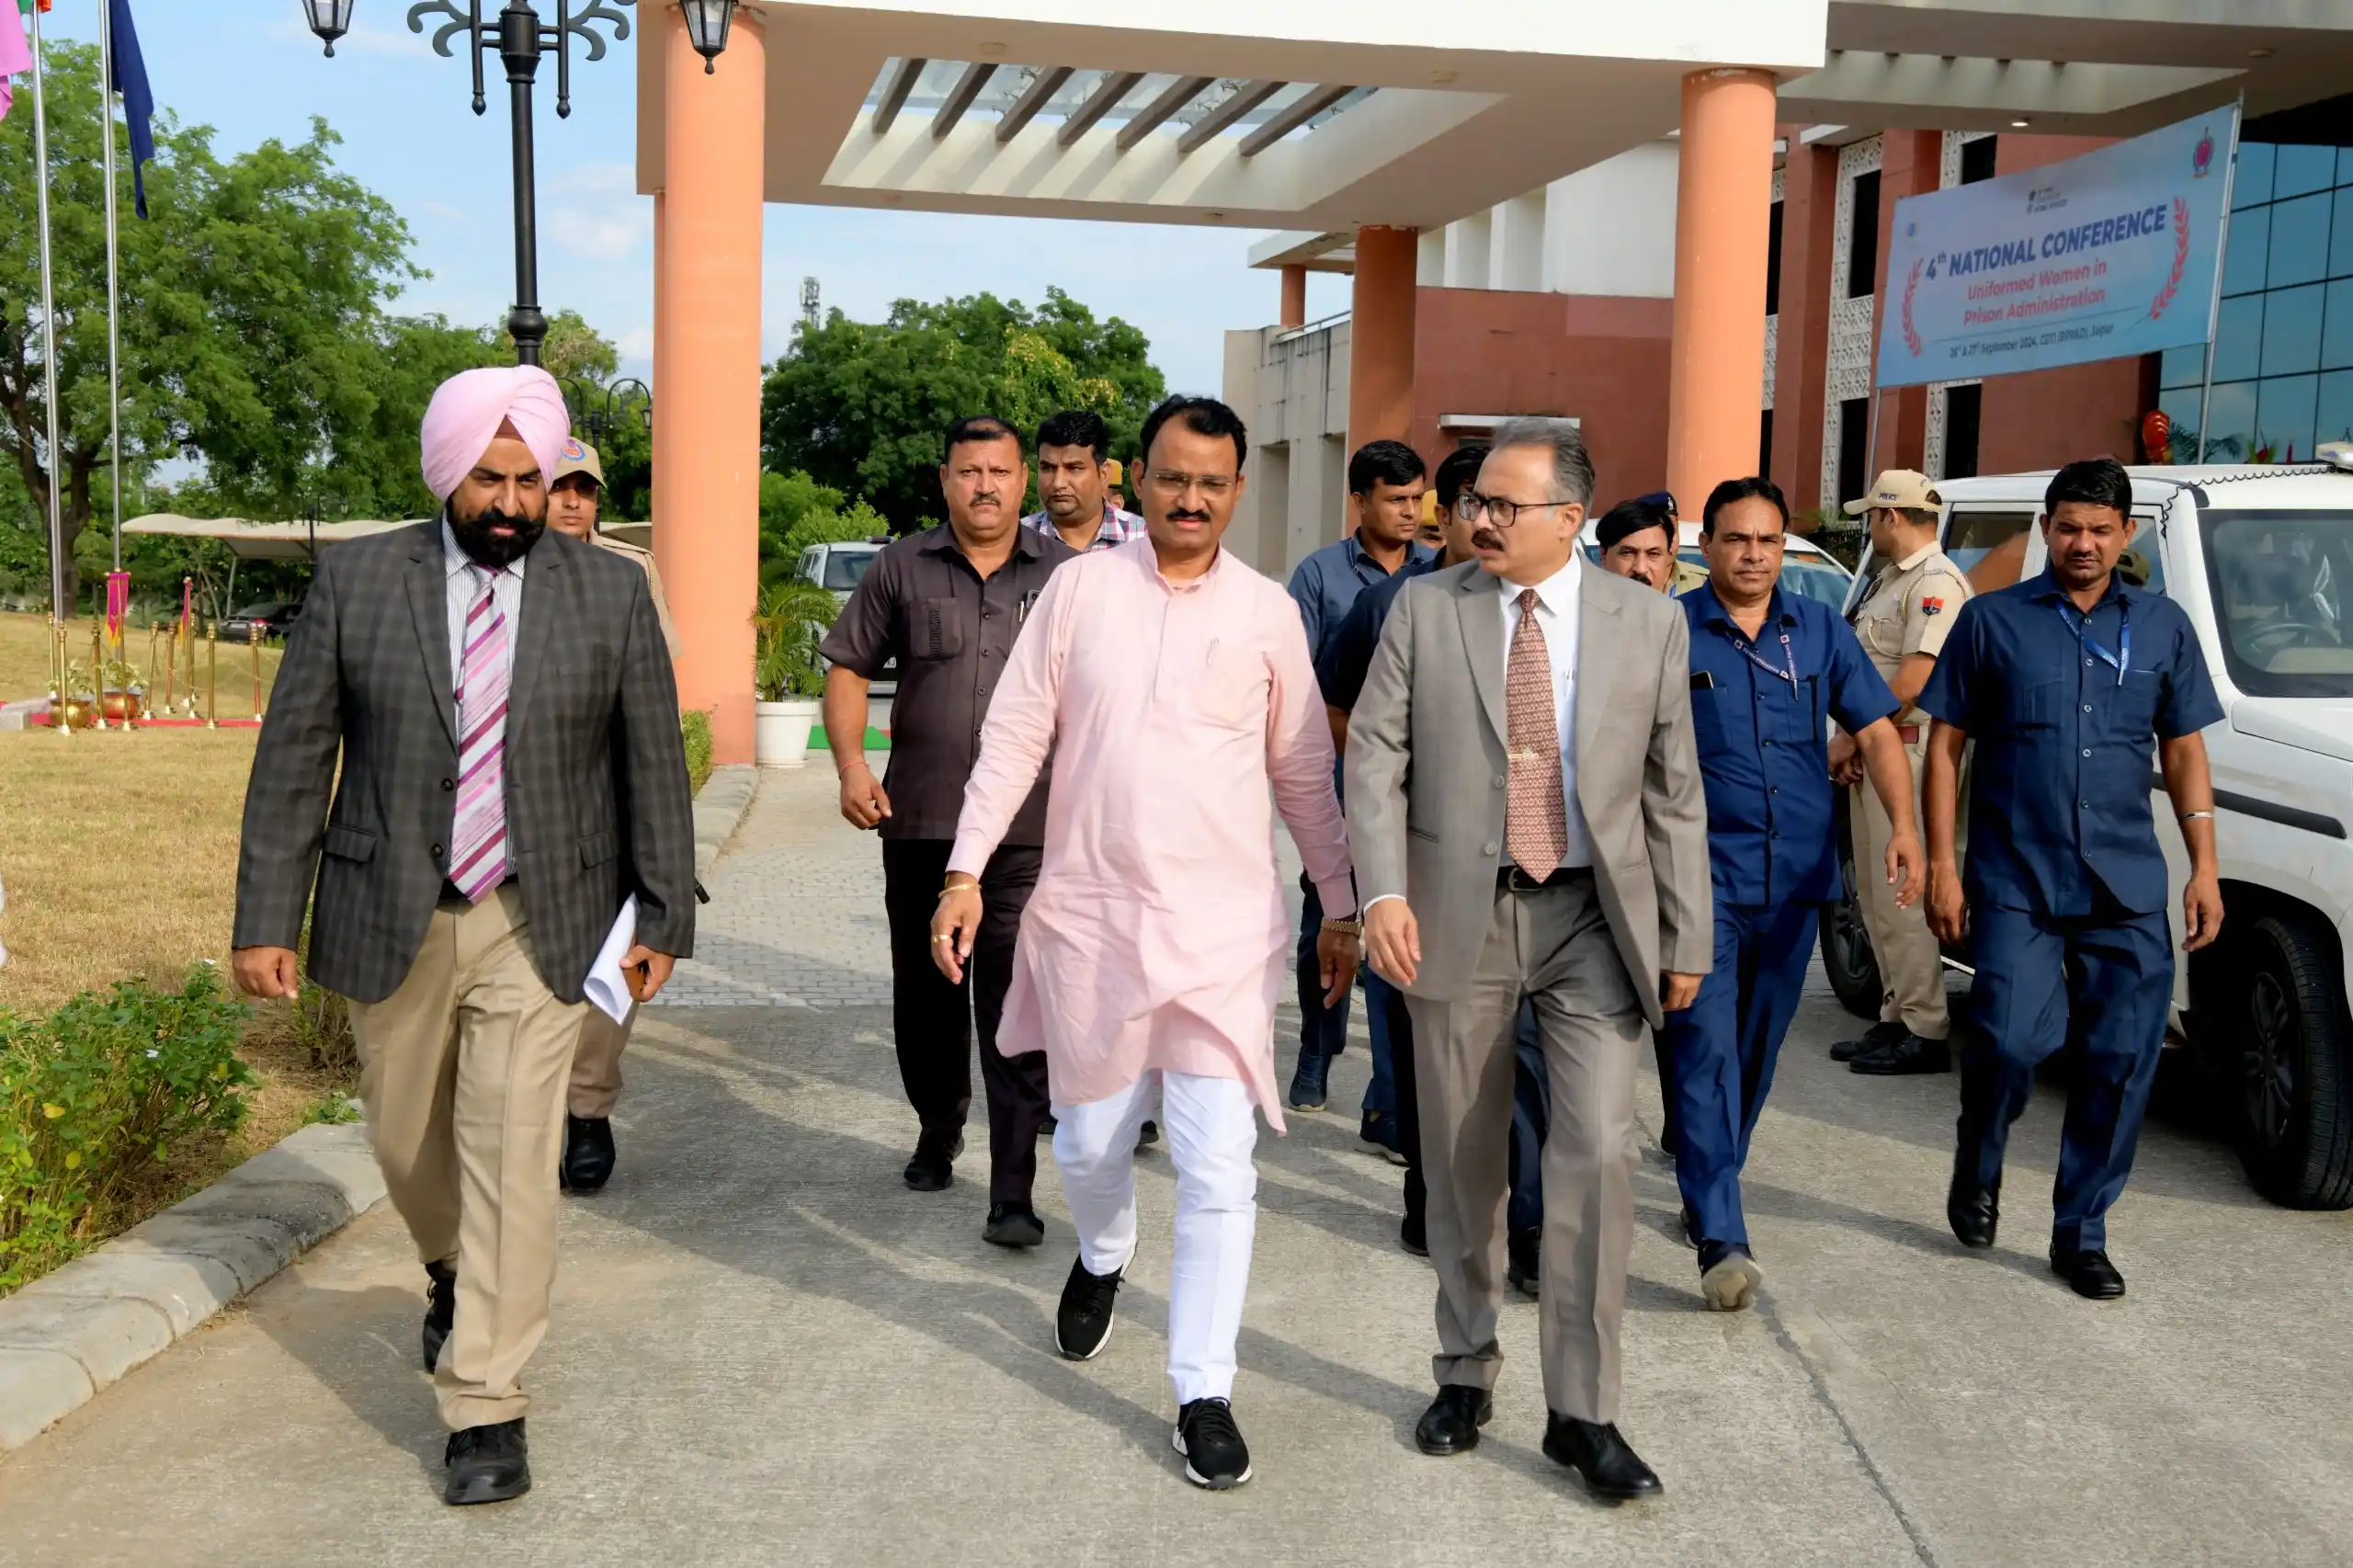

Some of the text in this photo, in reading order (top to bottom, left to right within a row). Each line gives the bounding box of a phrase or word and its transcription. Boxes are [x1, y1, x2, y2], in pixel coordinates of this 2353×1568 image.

[1949, 241, 2036, 277] NATIONAL
[2041, 204, 2167, 259] CONFERENCE
[1968, 258, 2107, 301] Uniformed Women in
[1963, 288, 2106, 326] Prison Administration
[1981, 339, 2018, 356] September
[2090, 323, 2114, 337] Jaipur
[1879, 493, 1897, 501] POLICE
[1743, 647, 1779, 674] RAJASTHAN POLICE
